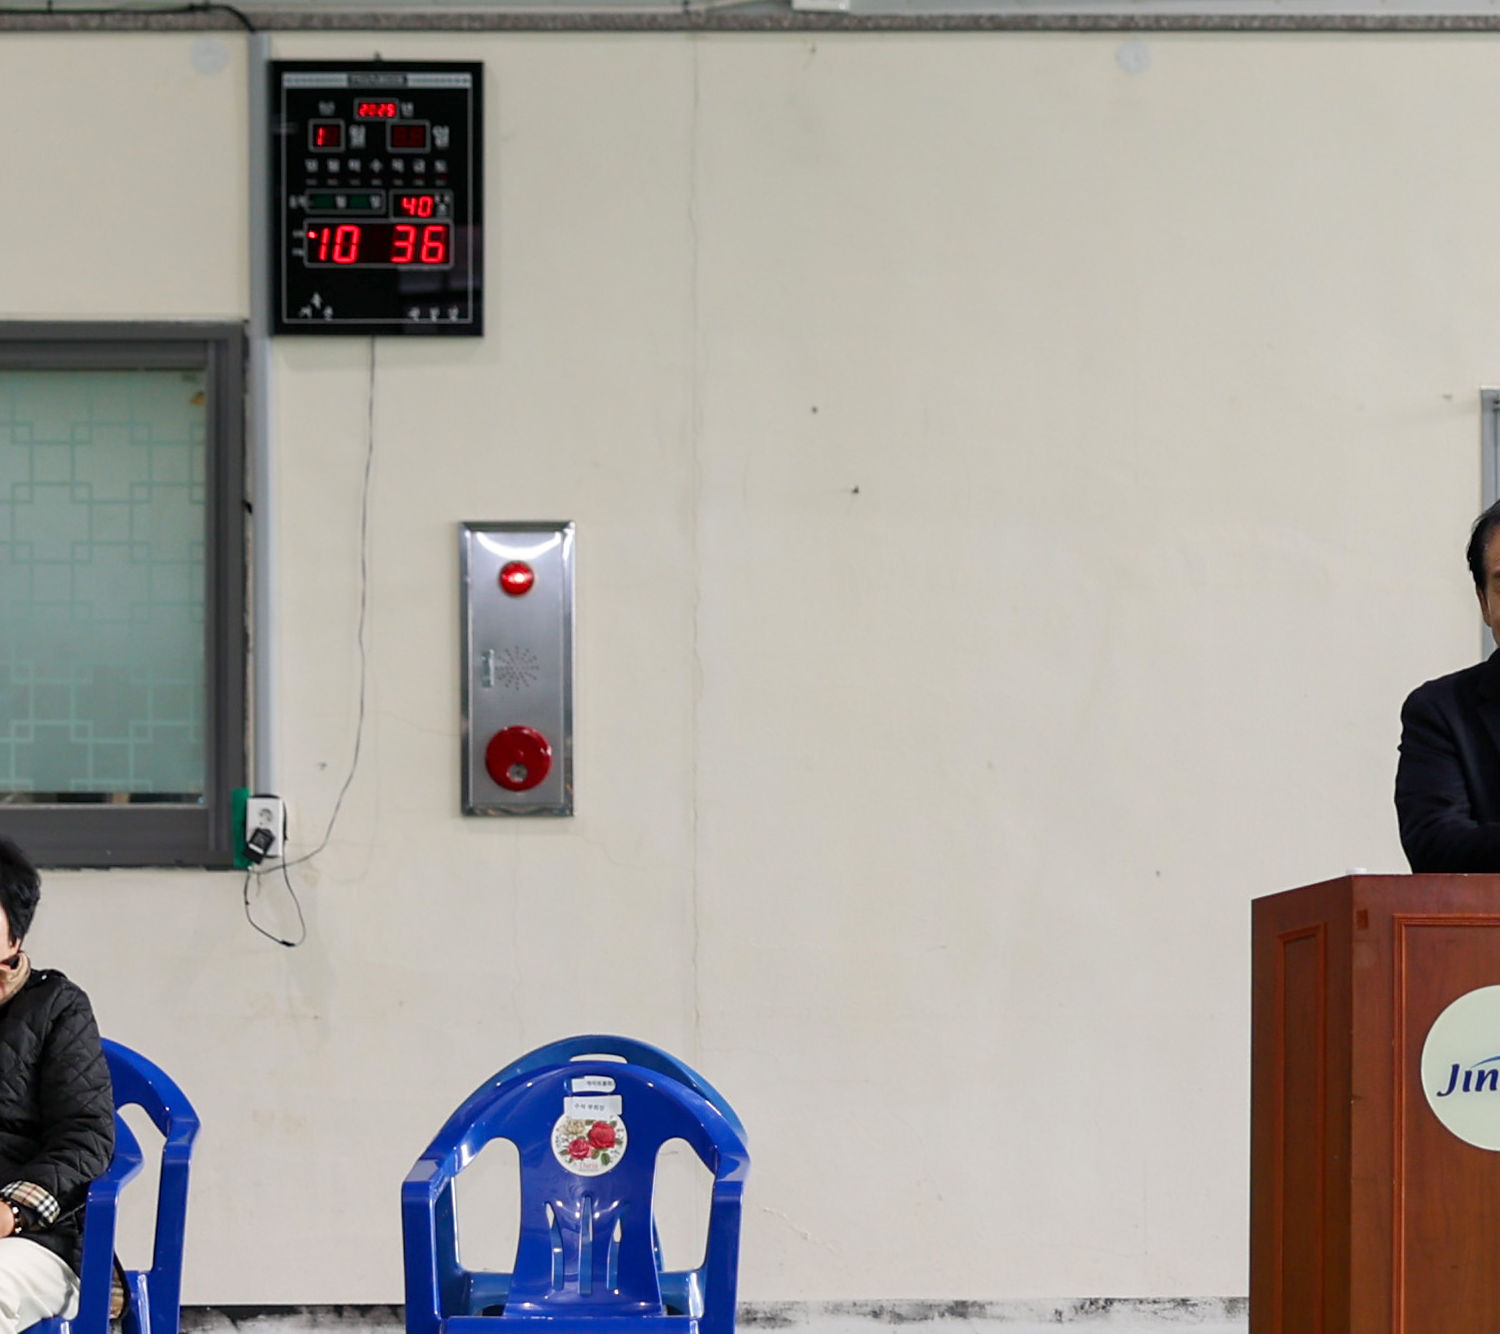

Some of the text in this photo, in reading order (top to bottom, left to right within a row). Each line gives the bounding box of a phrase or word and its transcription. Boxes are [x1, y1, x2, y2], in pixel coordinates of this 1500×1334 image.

[401, 195, 434, 218] 40
[318, 224, 446, 265] 10 36
